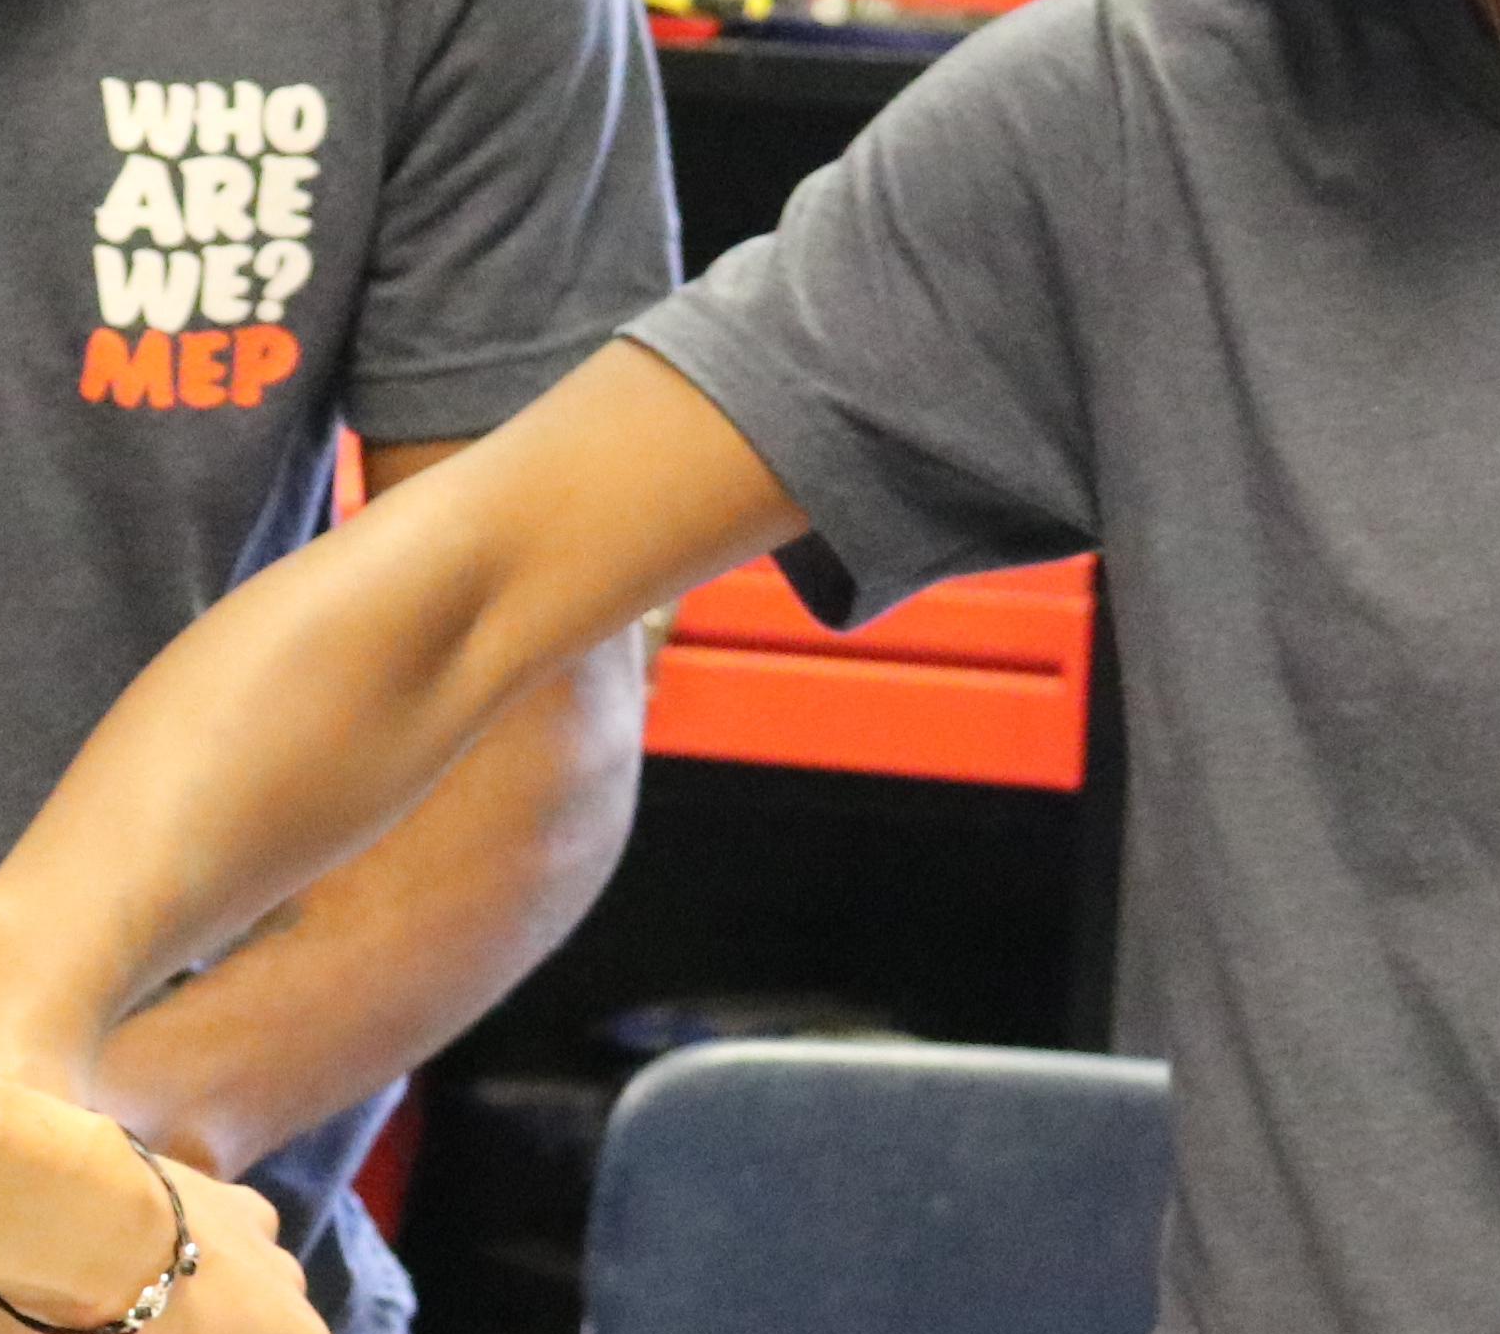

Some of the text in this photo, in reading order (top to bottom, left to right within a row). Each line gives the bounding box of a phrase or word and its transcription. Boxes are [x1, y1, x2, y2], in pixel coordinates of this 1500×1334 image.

[101, 76, 327, 157] WHO
[94, 153, 320, 246] ARE
[92, 239, 313, 333] WE?
[78, 323, 301, 409] MEP
